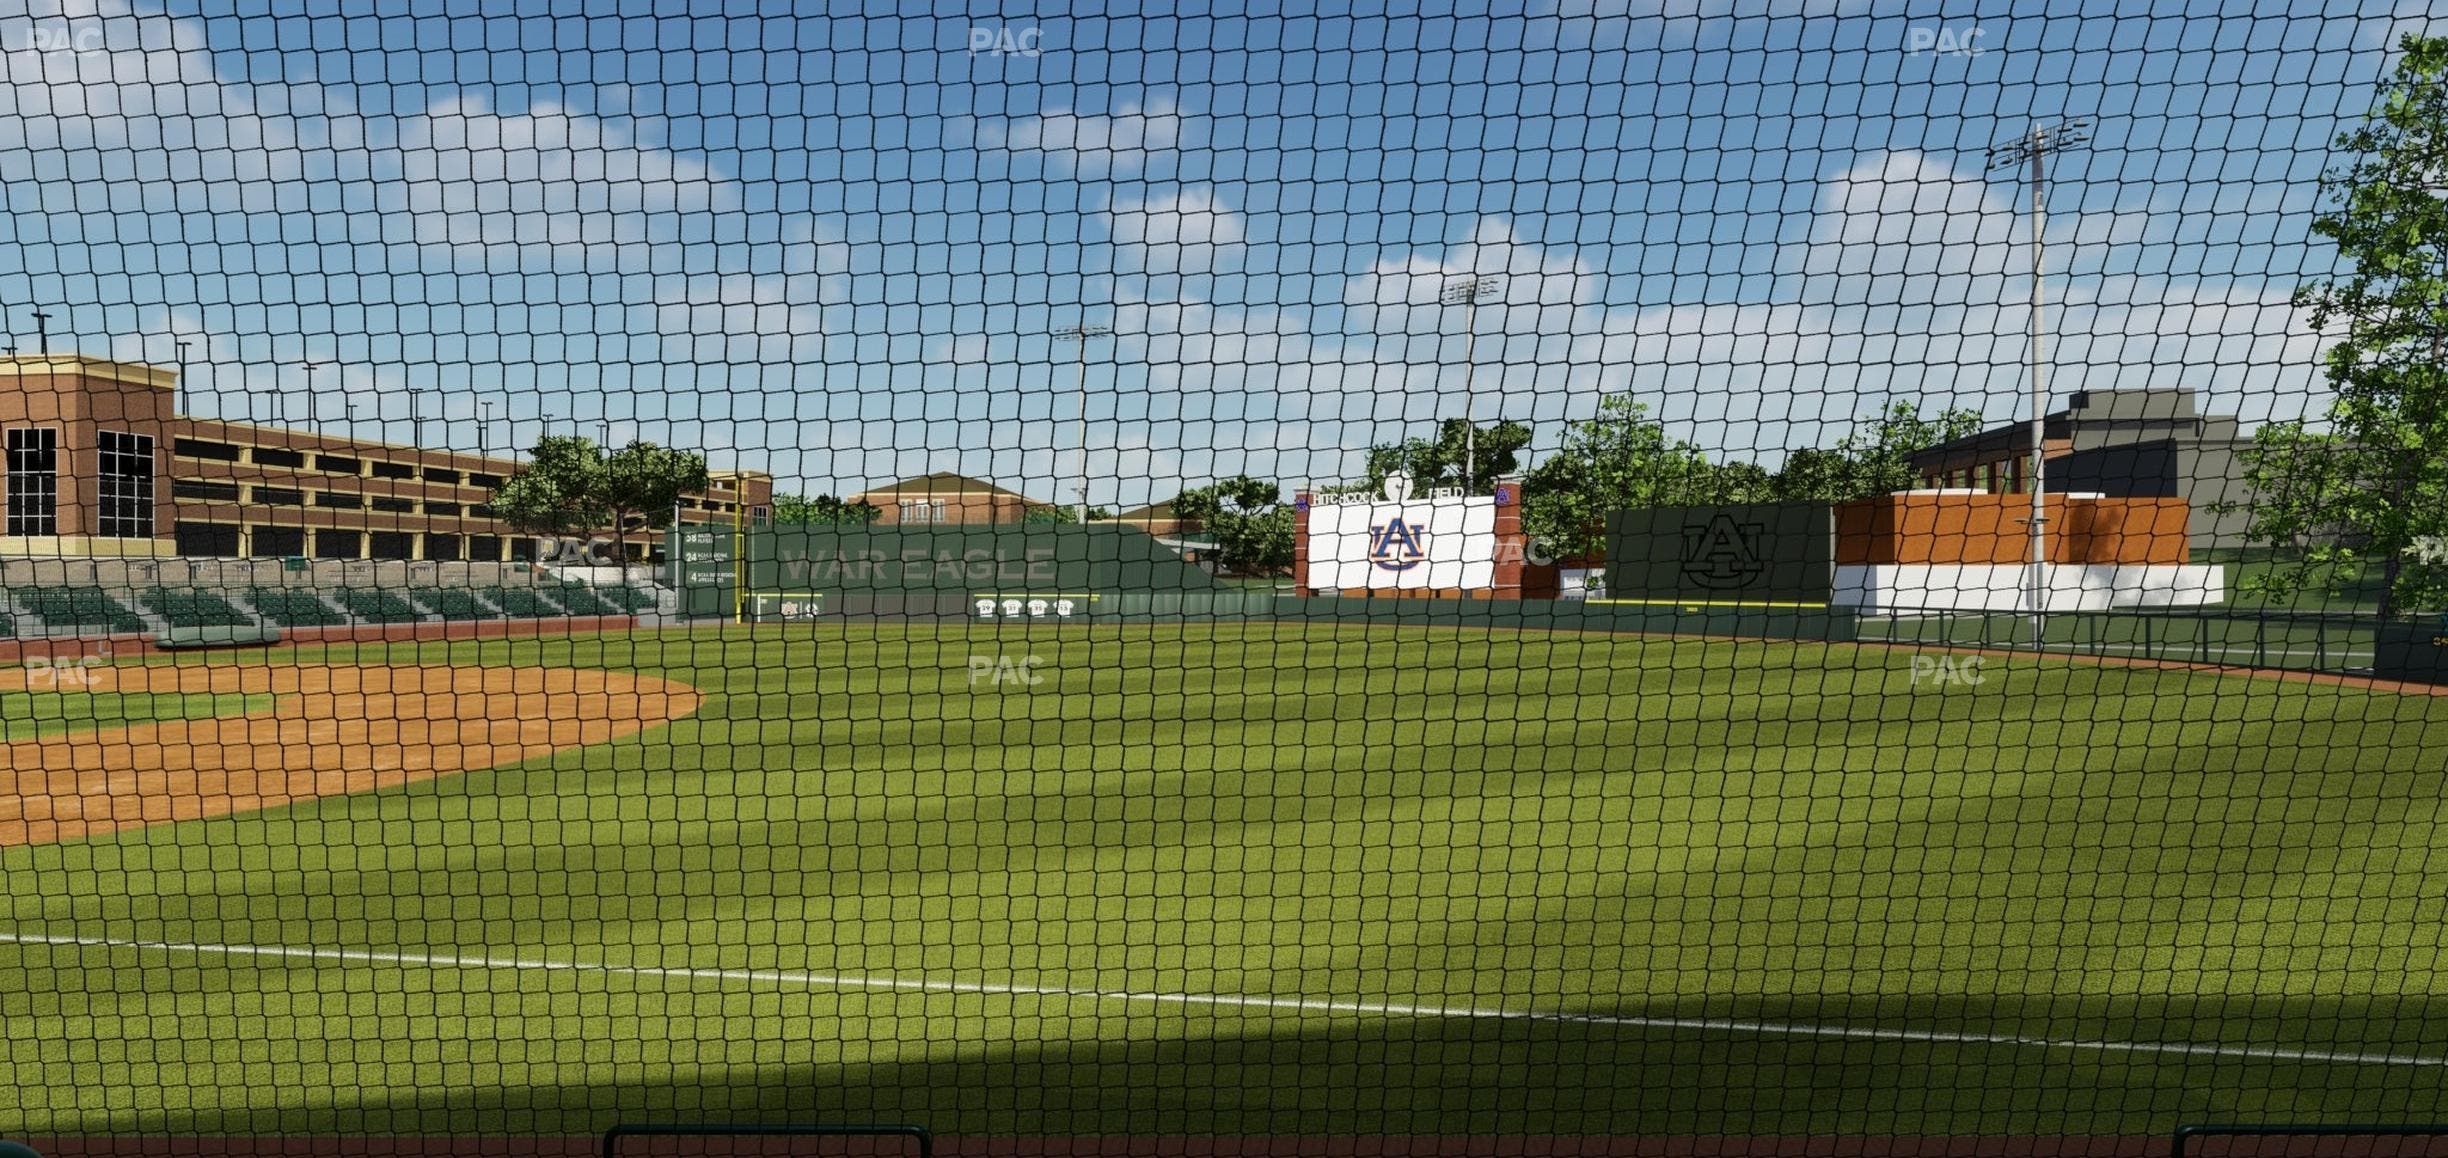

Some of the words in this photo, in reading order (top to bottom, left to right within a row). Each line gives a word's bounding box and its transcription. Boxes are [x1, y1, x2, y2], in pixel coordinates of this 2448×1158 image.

[1312, 491, 1379, 506] HITCHCOCK
[782, 549, 889, 580] WAR
[901, 548, 1057, 580] EAGLE
